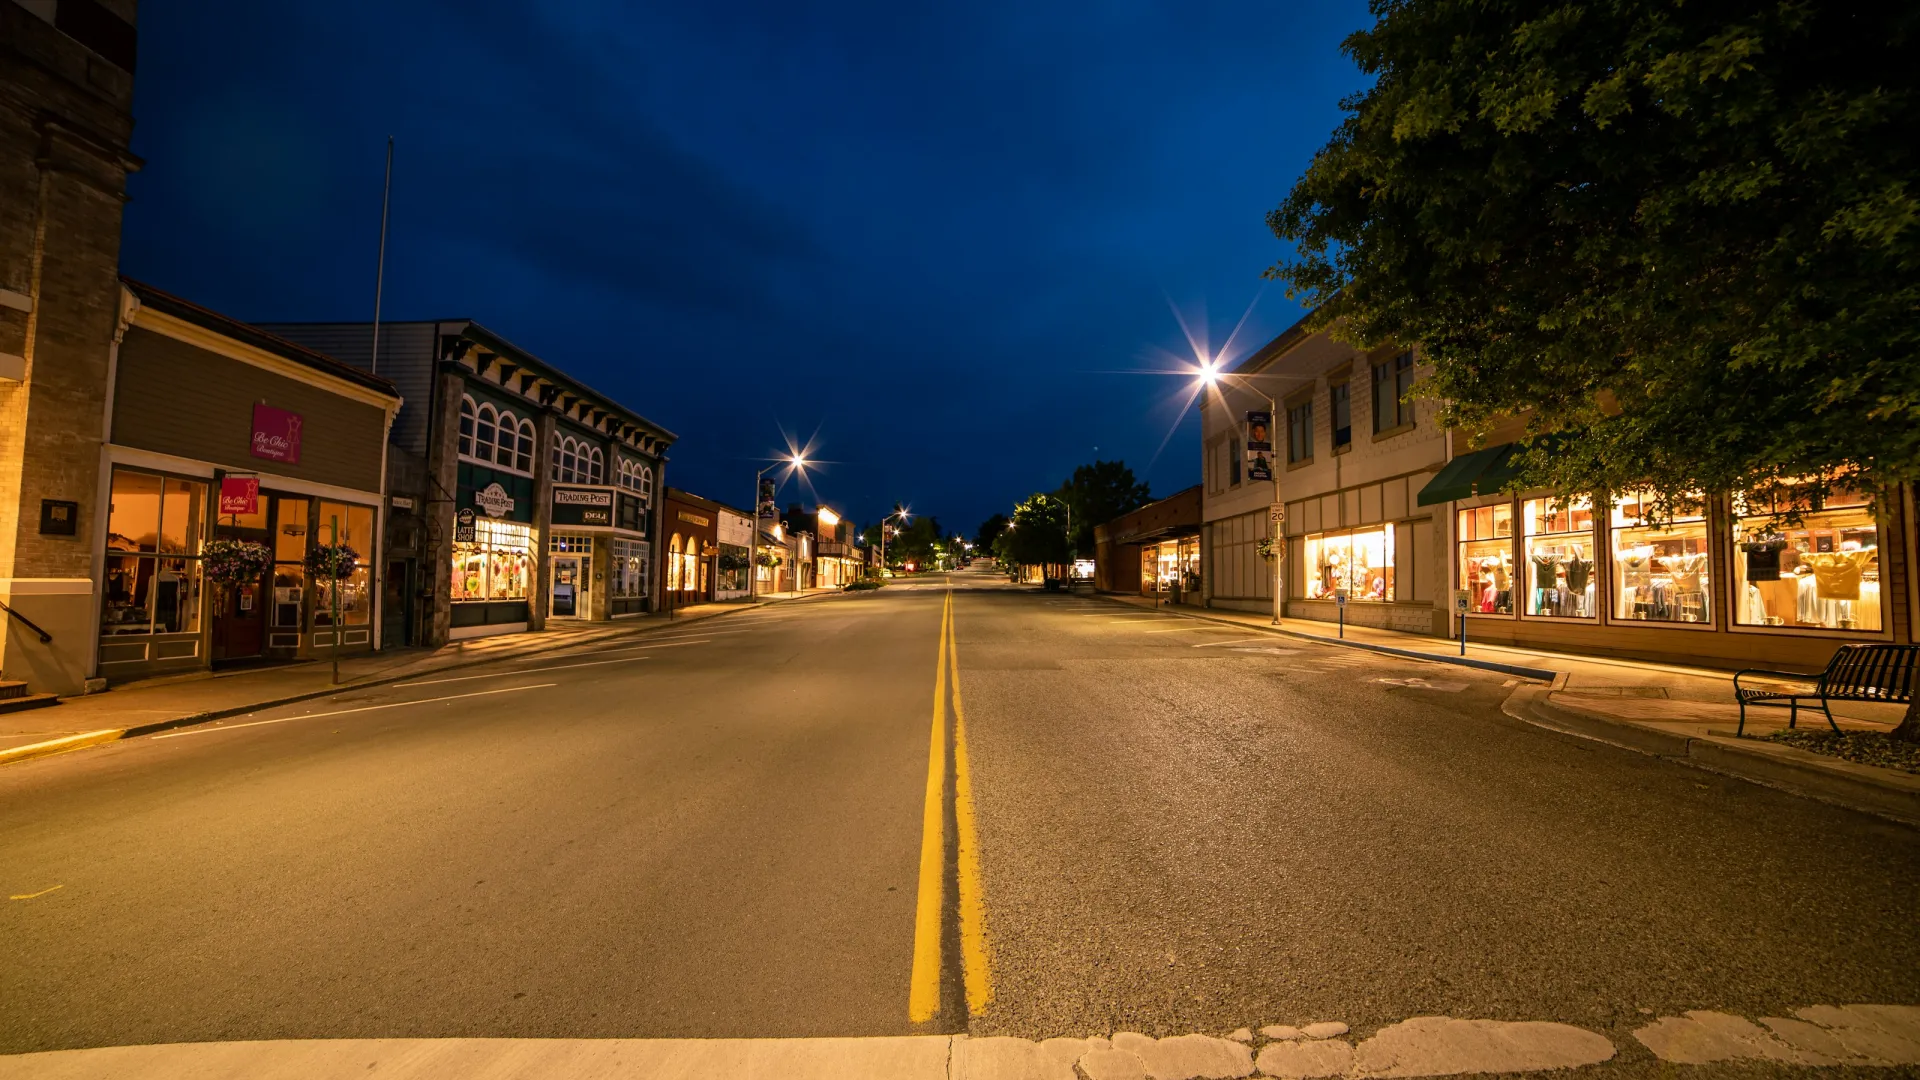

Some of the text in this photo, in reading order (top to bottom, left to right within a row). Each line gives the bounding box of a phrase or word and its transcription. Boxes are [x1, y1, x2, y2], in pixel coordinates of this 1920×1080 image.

[254, 432, 288, 449] Be Chic
[256, 445, 284, 458] Boutique
[558, 491, 609, 503] TRADING POST
[500, 498, 513, 508] POST
[585, 512, 606, 520] DELI
[1272, 512, 1284, 521] 20
[457, 526, 474, 534] LATTE
[457, 534, 473, 542] SHOP
